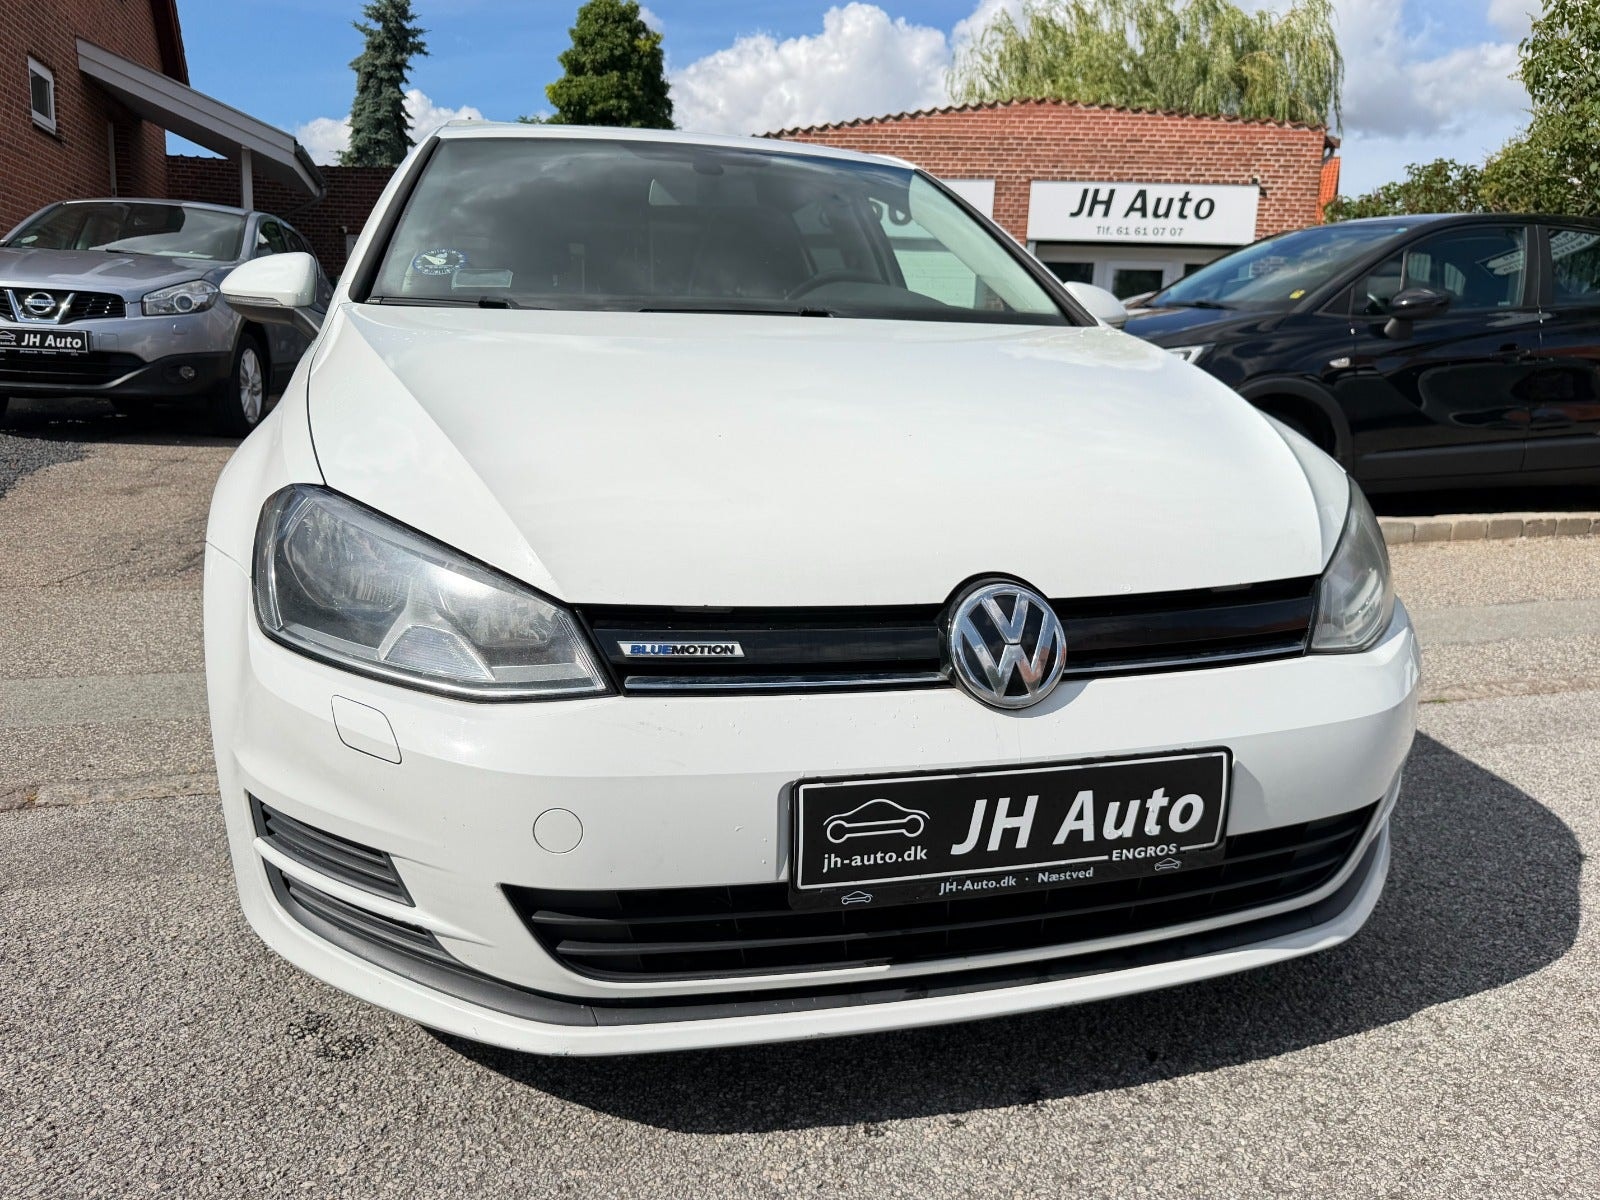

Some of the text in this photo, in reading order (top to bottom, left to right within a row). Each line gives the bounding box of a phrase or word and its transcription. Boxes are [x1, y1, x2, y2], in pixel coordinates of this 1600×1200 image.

[1069, 188, 1216, 220] JH Auto
[1096, 225, 1184, 237] Tlf. 61 61 07 07
[21, 333, 82, 348] JH Auto
[629, 644, 736, 655] BLUEMOTION
[950, 787, 1205, 855] JH Auto
[822, 845, 928, 874] jh-auto.dk
[1111, 843, 1178, 861] ENGROS
[938, 866, 1094, 896] JH-Auto.dk Næstved
